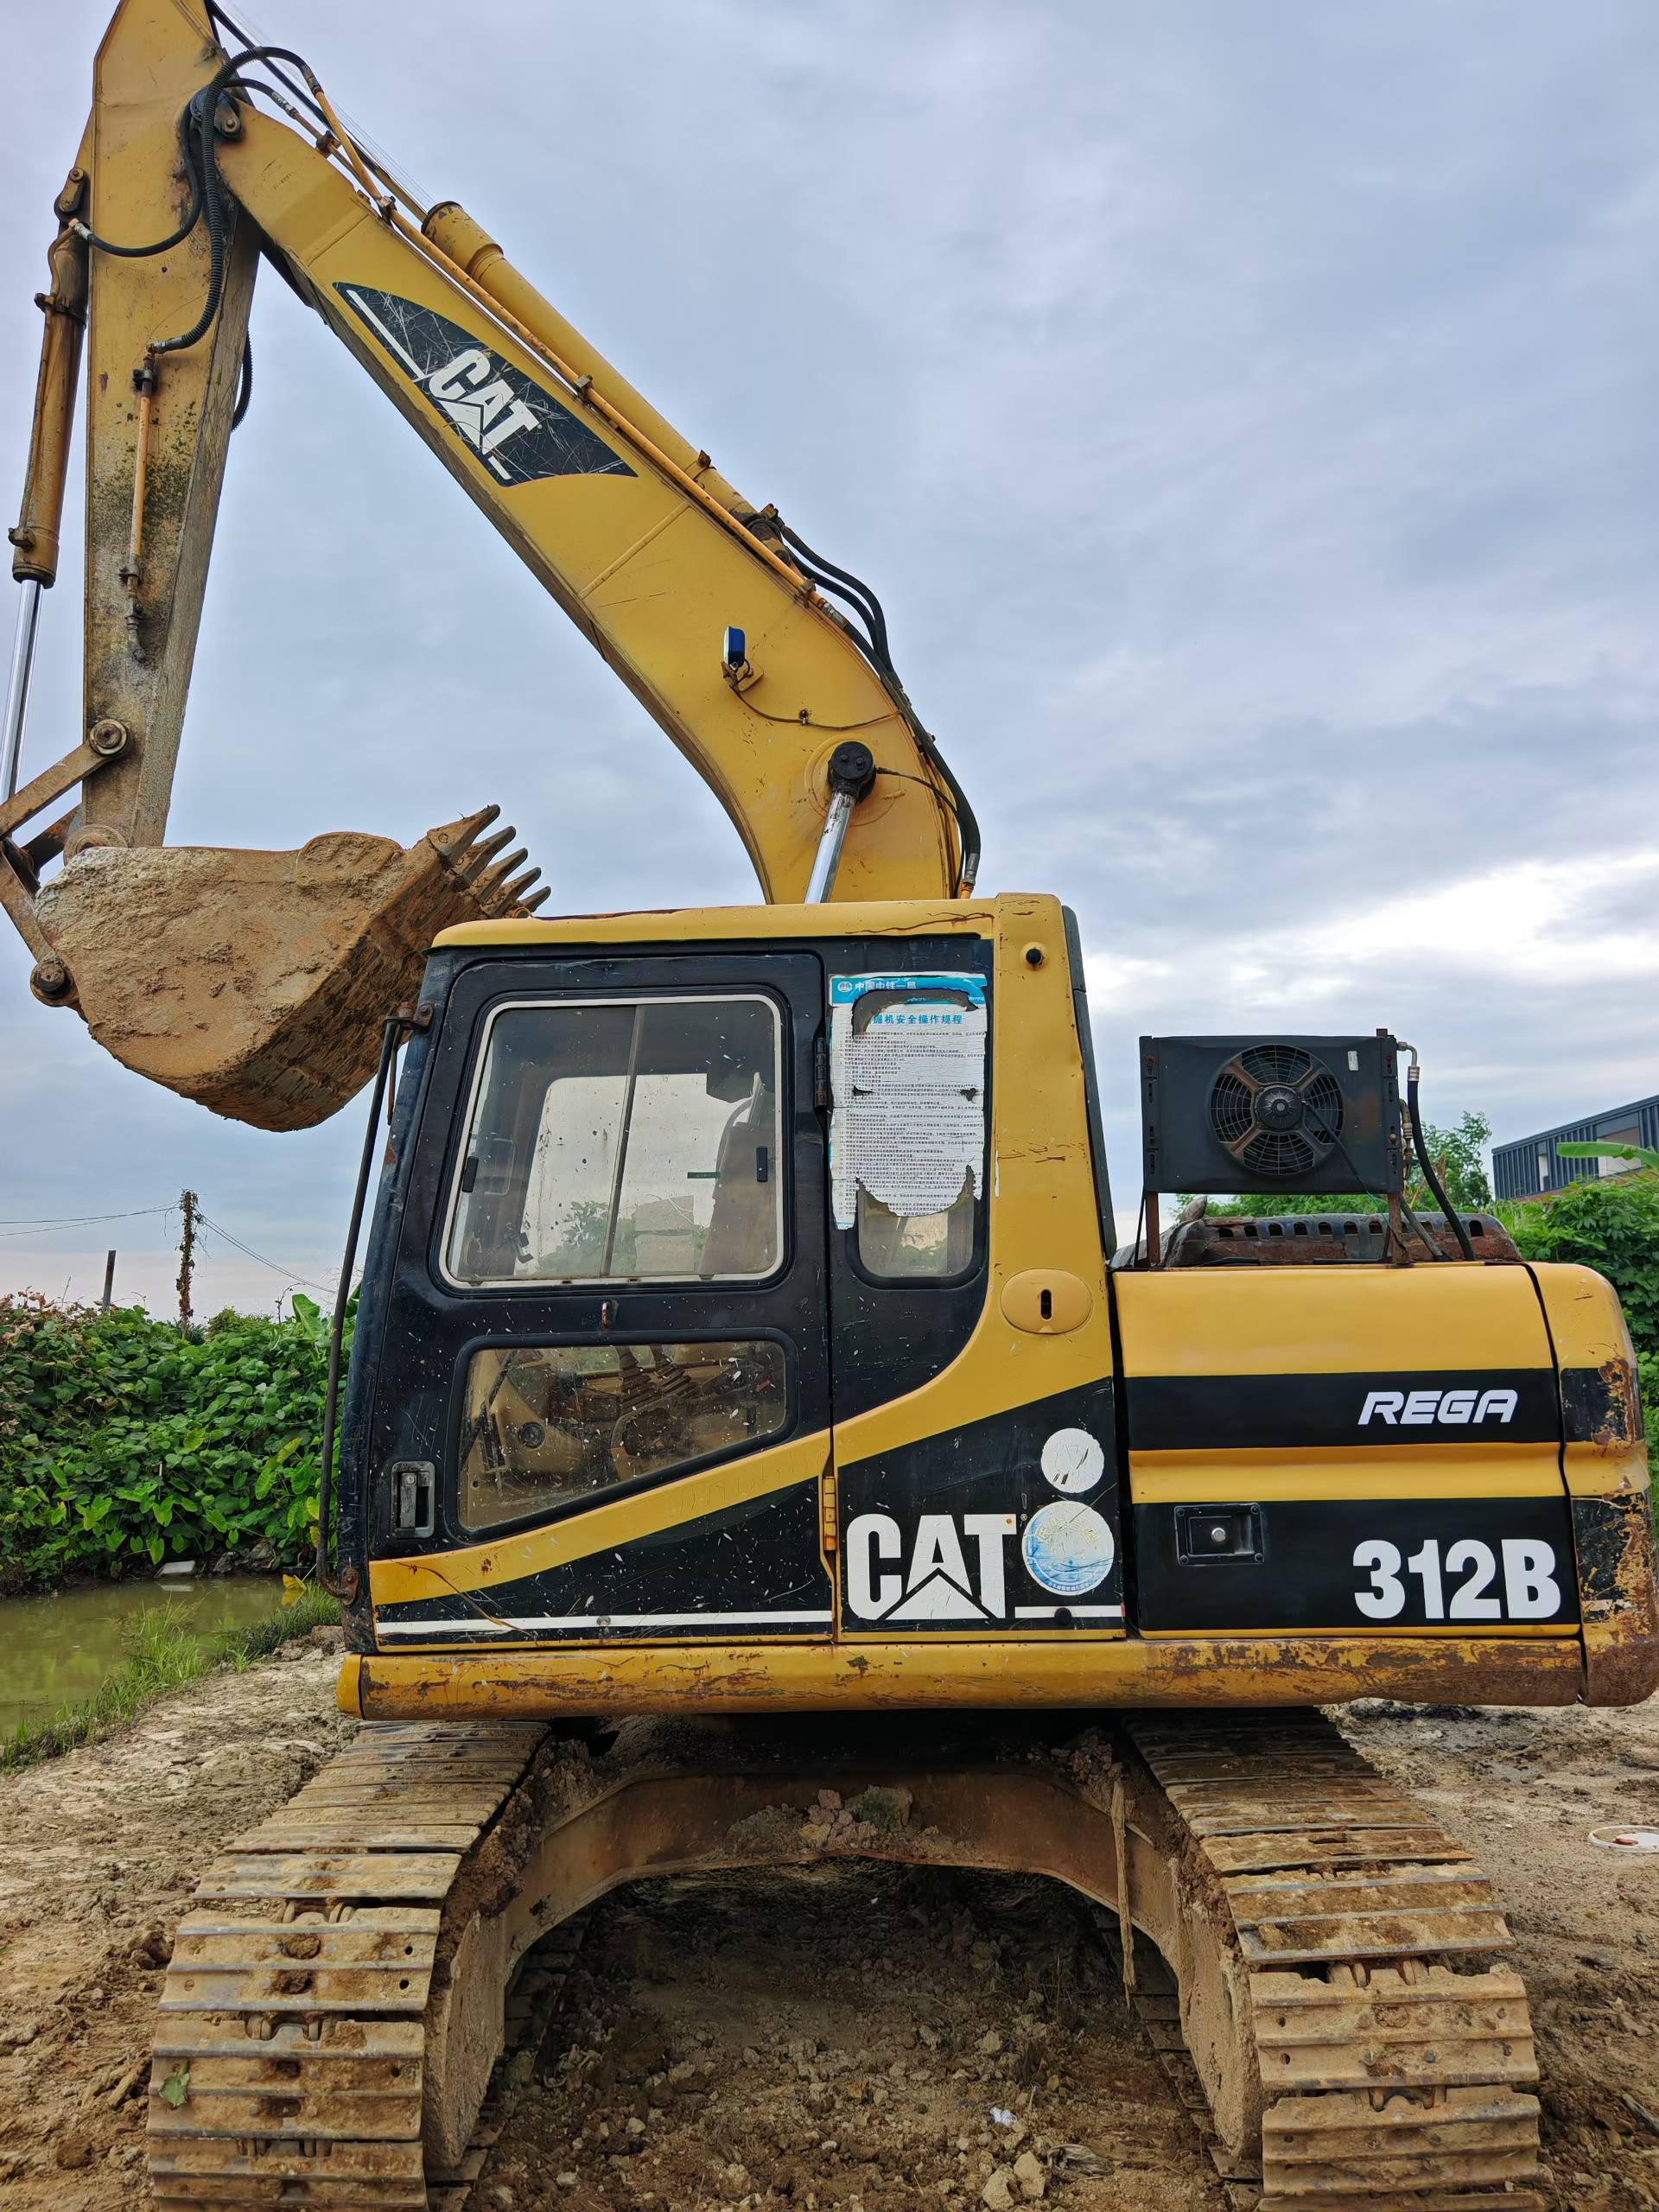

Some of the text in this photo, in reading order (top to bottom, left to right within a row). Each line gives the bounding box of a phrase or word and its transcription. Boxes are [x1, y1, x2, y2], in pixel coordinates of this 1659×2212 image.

[429, 349, 540, 455] CAT
[1357, 1389, 1518, 1425] REGA
[846, 1513, 1017, 1620] CAT
[1352, 1539, 1561, 1619] 312B
